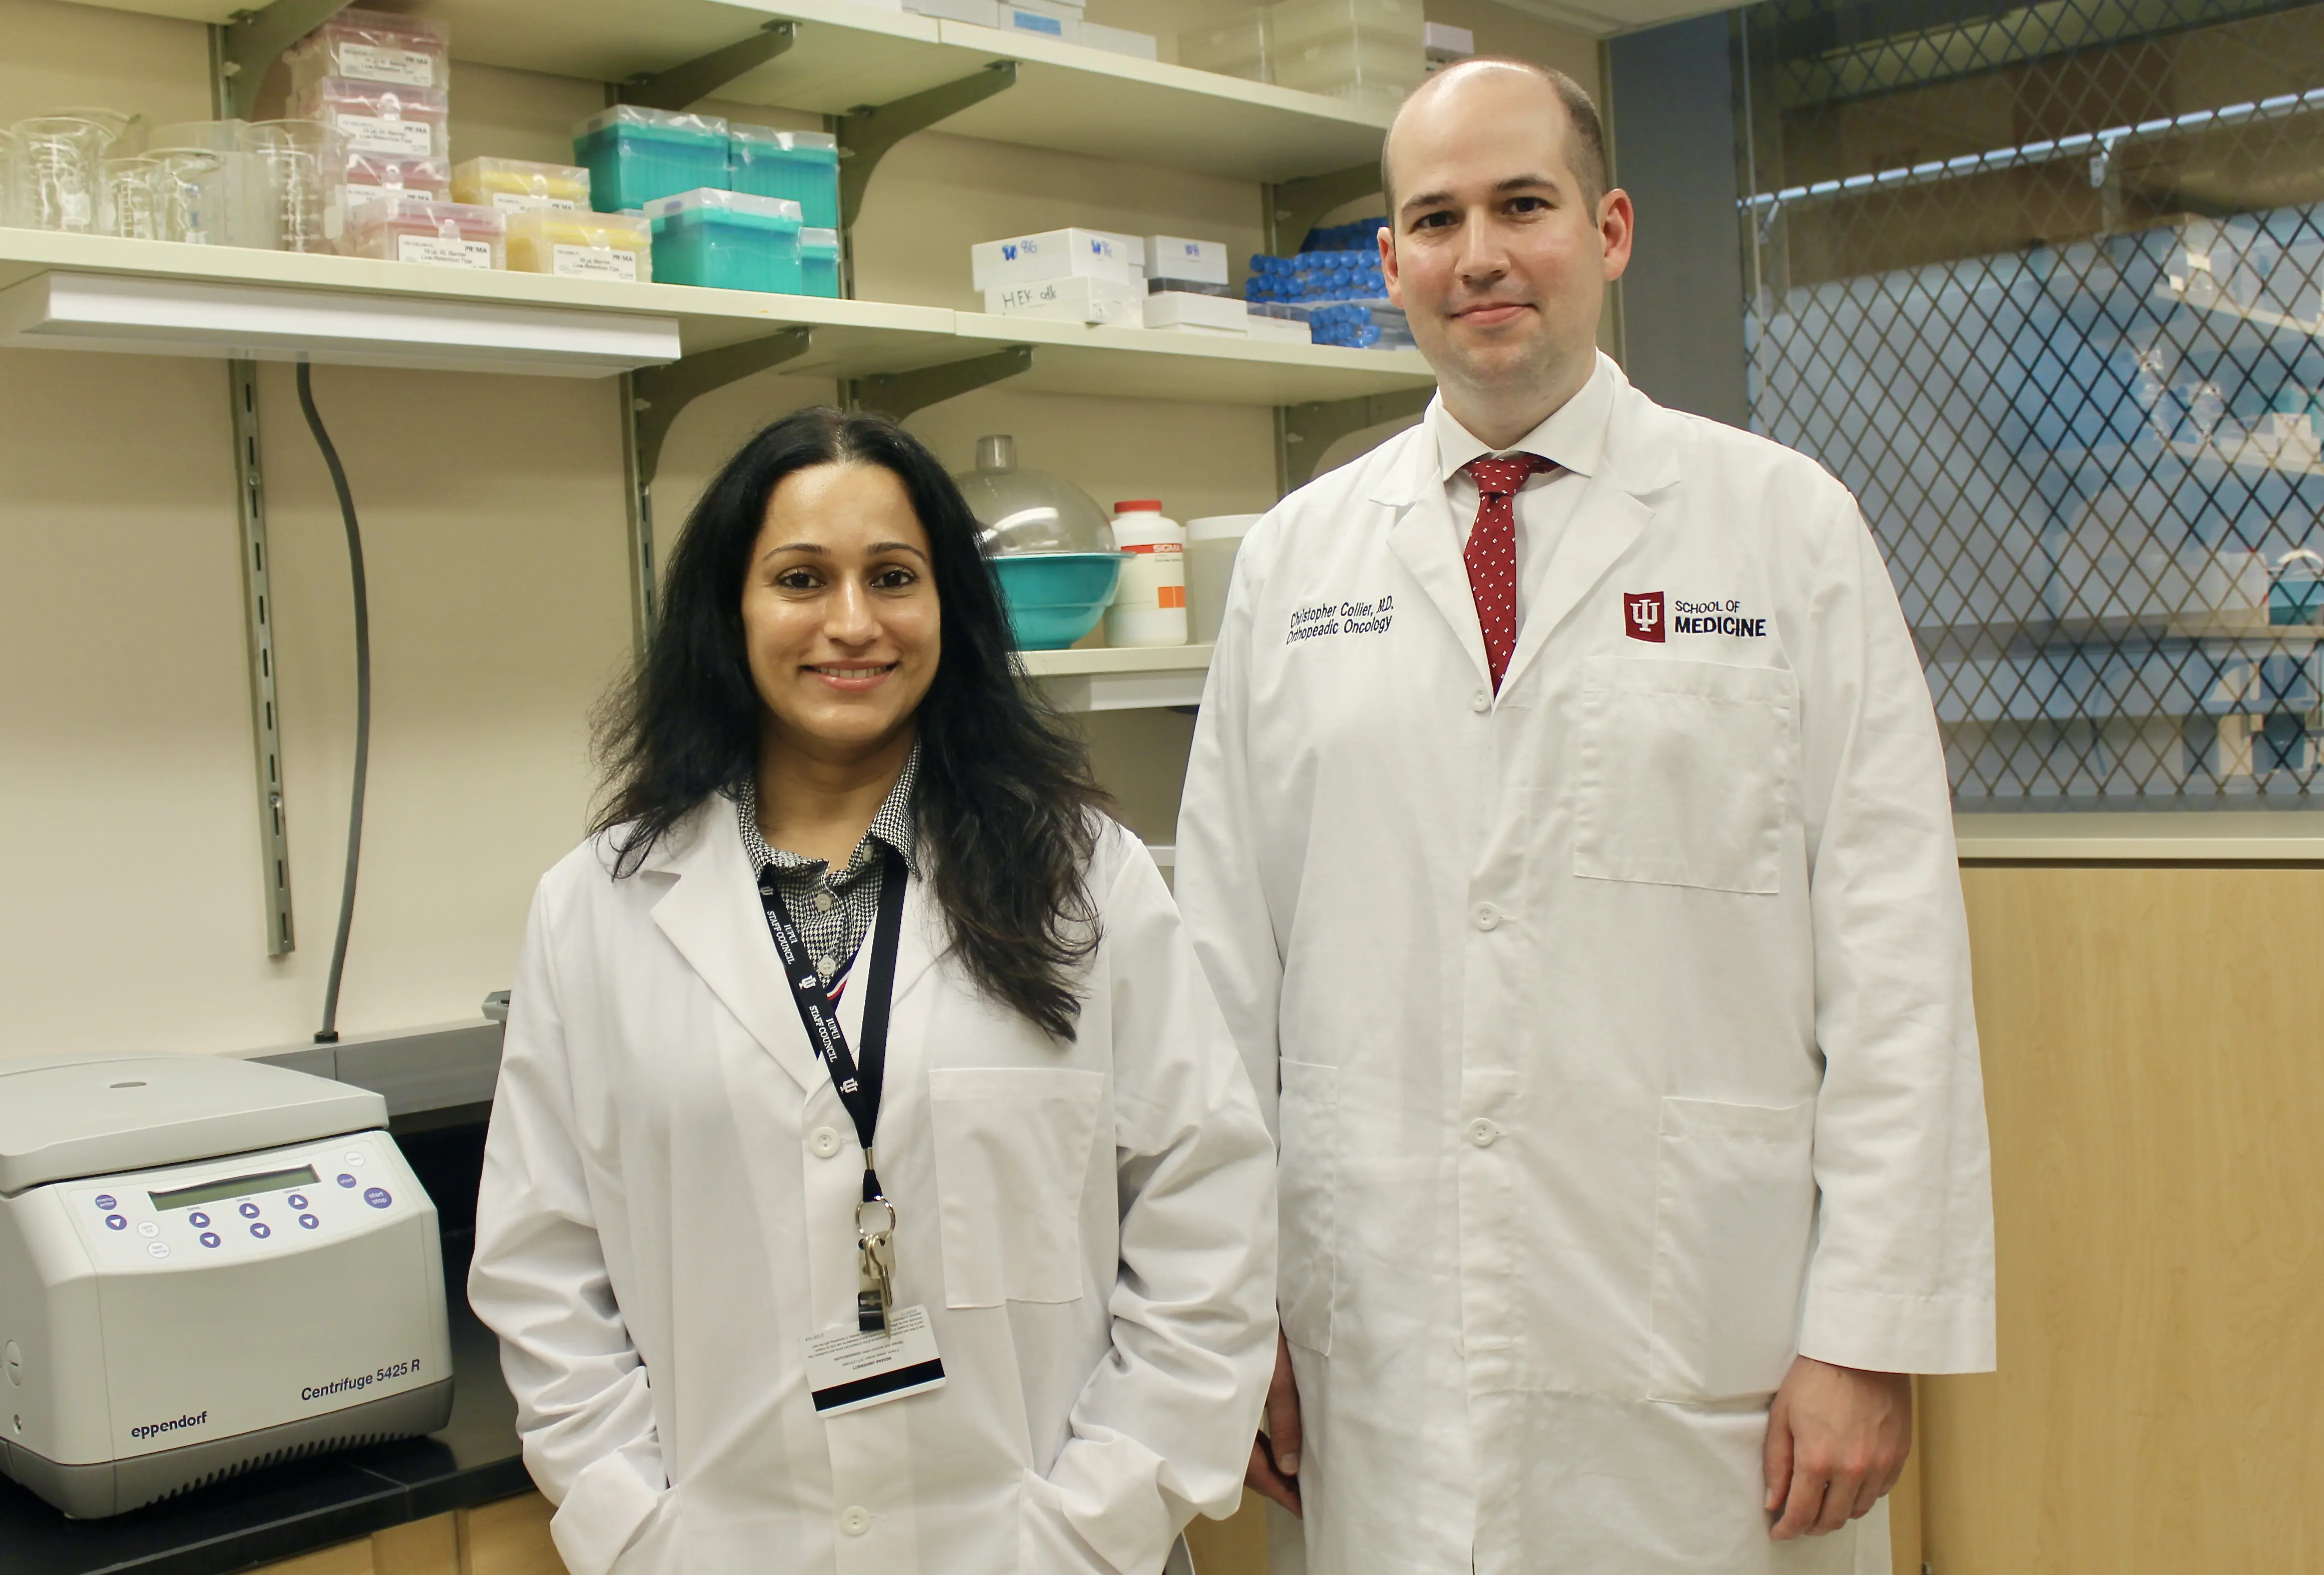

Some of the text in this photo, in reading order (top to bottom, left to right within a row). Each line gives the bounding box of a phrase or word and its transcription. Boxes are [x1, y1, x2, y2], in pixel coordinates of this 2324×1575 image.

[1002, 289, 1032, 308] HEK
[1153, 544, 1180, 553] SIGMA
[1290, 603, 1337, 629] Christopher
[1340, 602, 1373, 617] Collier,
[1675, 600, 1741, 614] SCHOOL OF
[1286, 615, 1392, 645] Orthopeadic Oncology
[1675, 616, 1766, 637] MEDICINE
[767, 910, 795, 965] STAFF COUNCIL
[783, 924, 798, 944] IUPUI
[809, 1005, 837, 1063] STAFF COUNCIL
[826, 1018, 841, 1040] IUPUI
[301, 1359, 420, 1401] Centrifuge 5425 R
[131, 1411, 207, 1439] eppendorf
